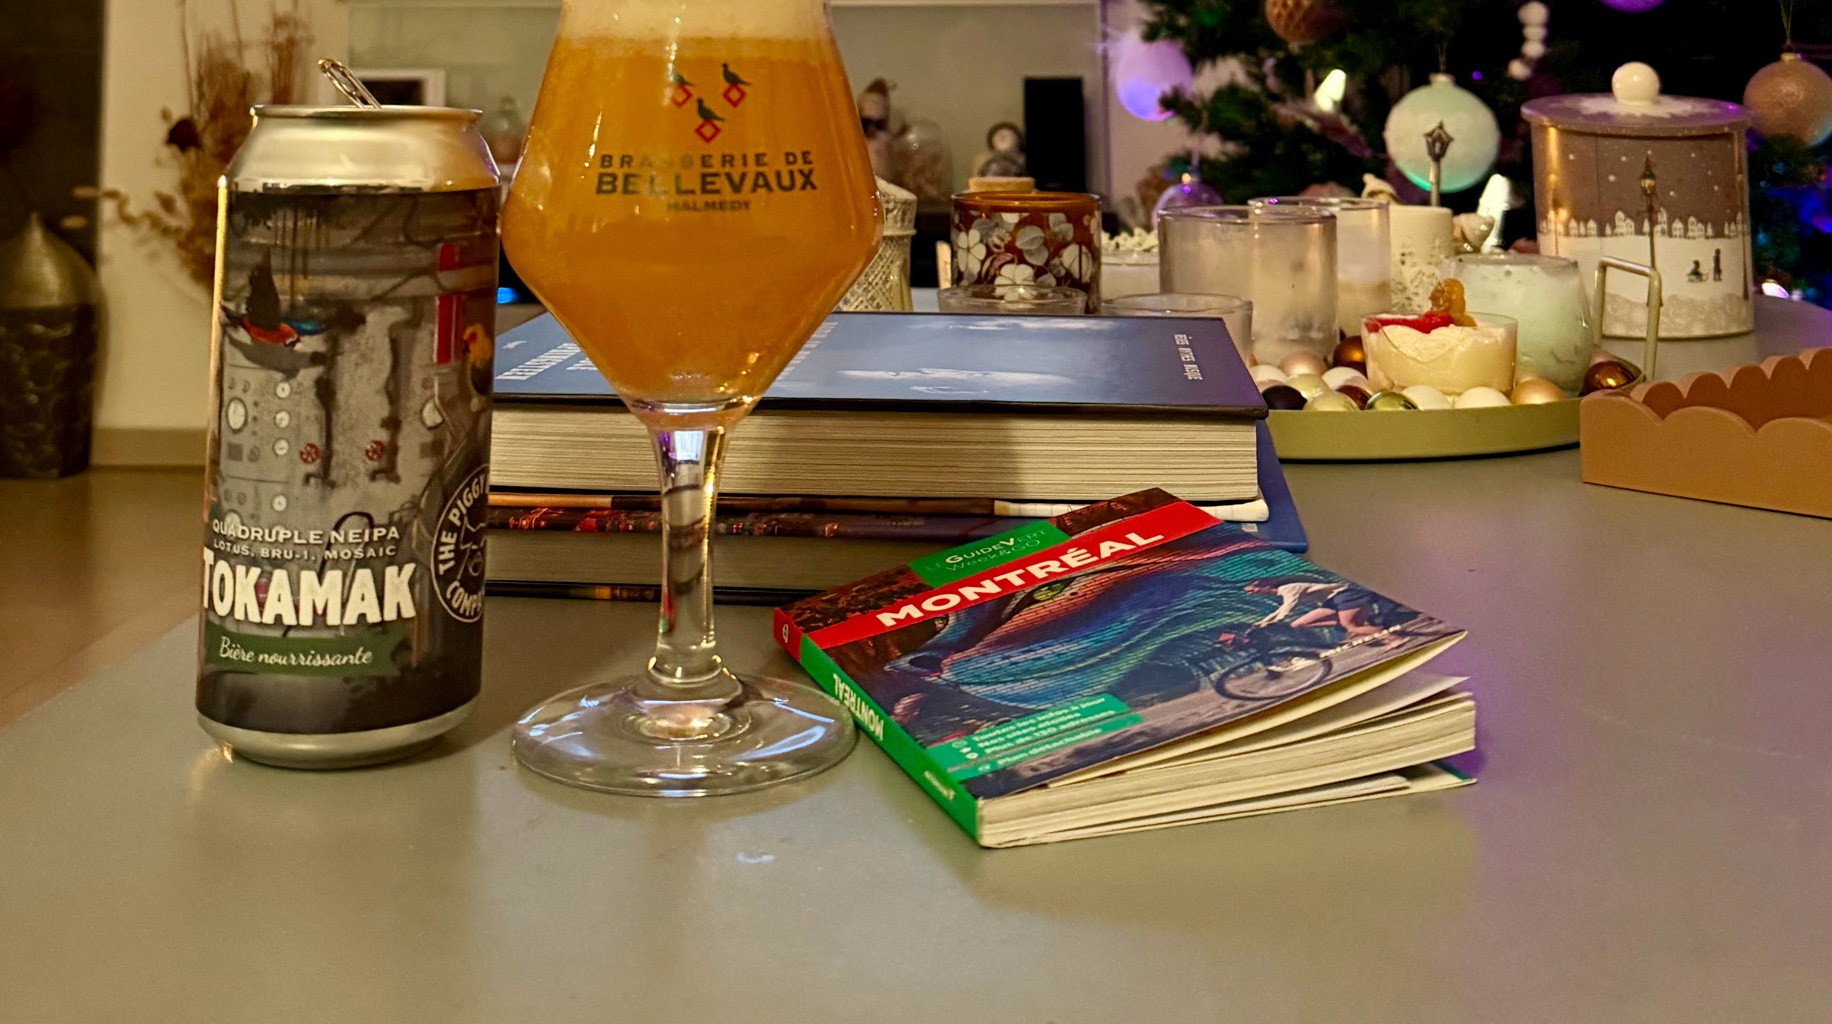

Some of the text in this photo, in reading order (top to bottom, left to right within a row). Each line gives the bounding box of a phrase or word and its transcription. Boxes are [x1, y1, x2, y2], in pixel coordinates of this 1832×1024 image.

[785, 151, 813, 166] DE
[595, 168, 818, 195] BELLEVAUX
[212, 518, 400, 545] QUADRUPLE NEIPA
[323, 545, 397, 560] MOSAIC
[438, 531, 458, 575] THE
[203, 545, 417, 626] TOKAMAK
[876, 532, 1164, 627] MONTRÉAL
[257, 646, 373, 667] nourrissante
